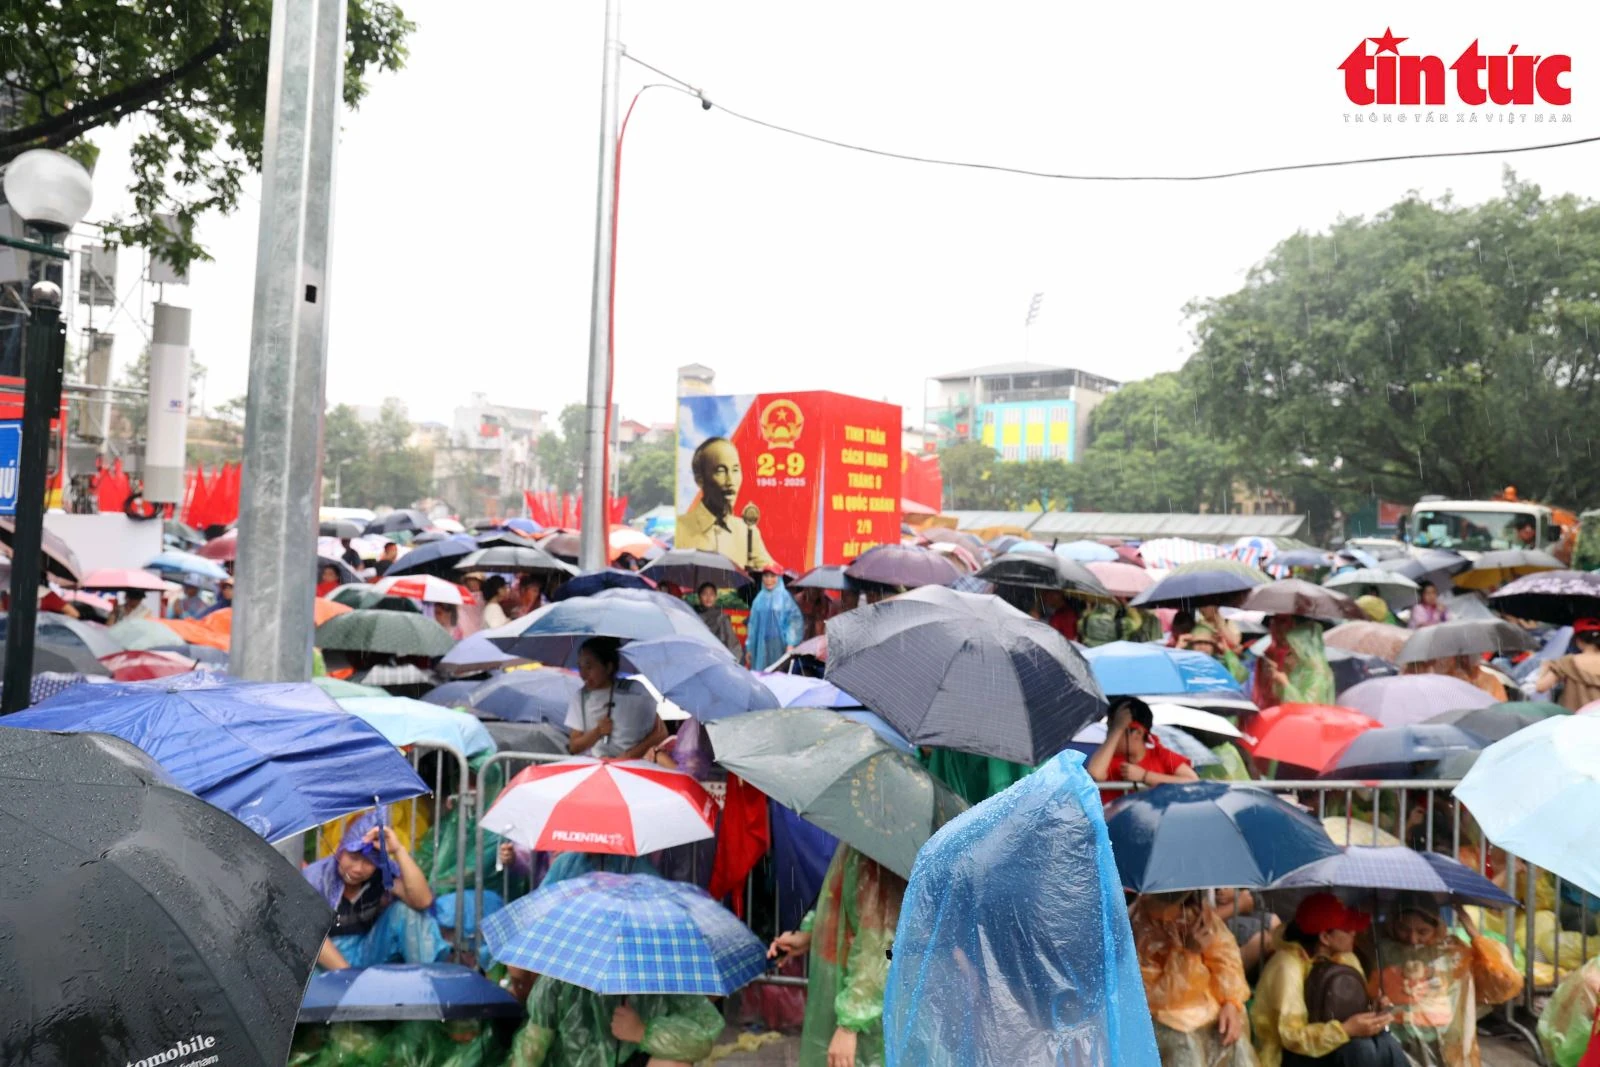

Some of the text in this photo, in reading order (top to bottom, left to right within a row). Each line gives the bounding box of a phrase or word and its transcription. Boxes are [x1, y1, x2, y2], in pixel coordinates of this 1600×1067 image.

[757, 452, 806, 477] 2-9
[841, 447, 865, 466] CÁCH
[845, 491, 868, 512] QUỐC
[552, 830, 609, 845] PRUDENTIAL
